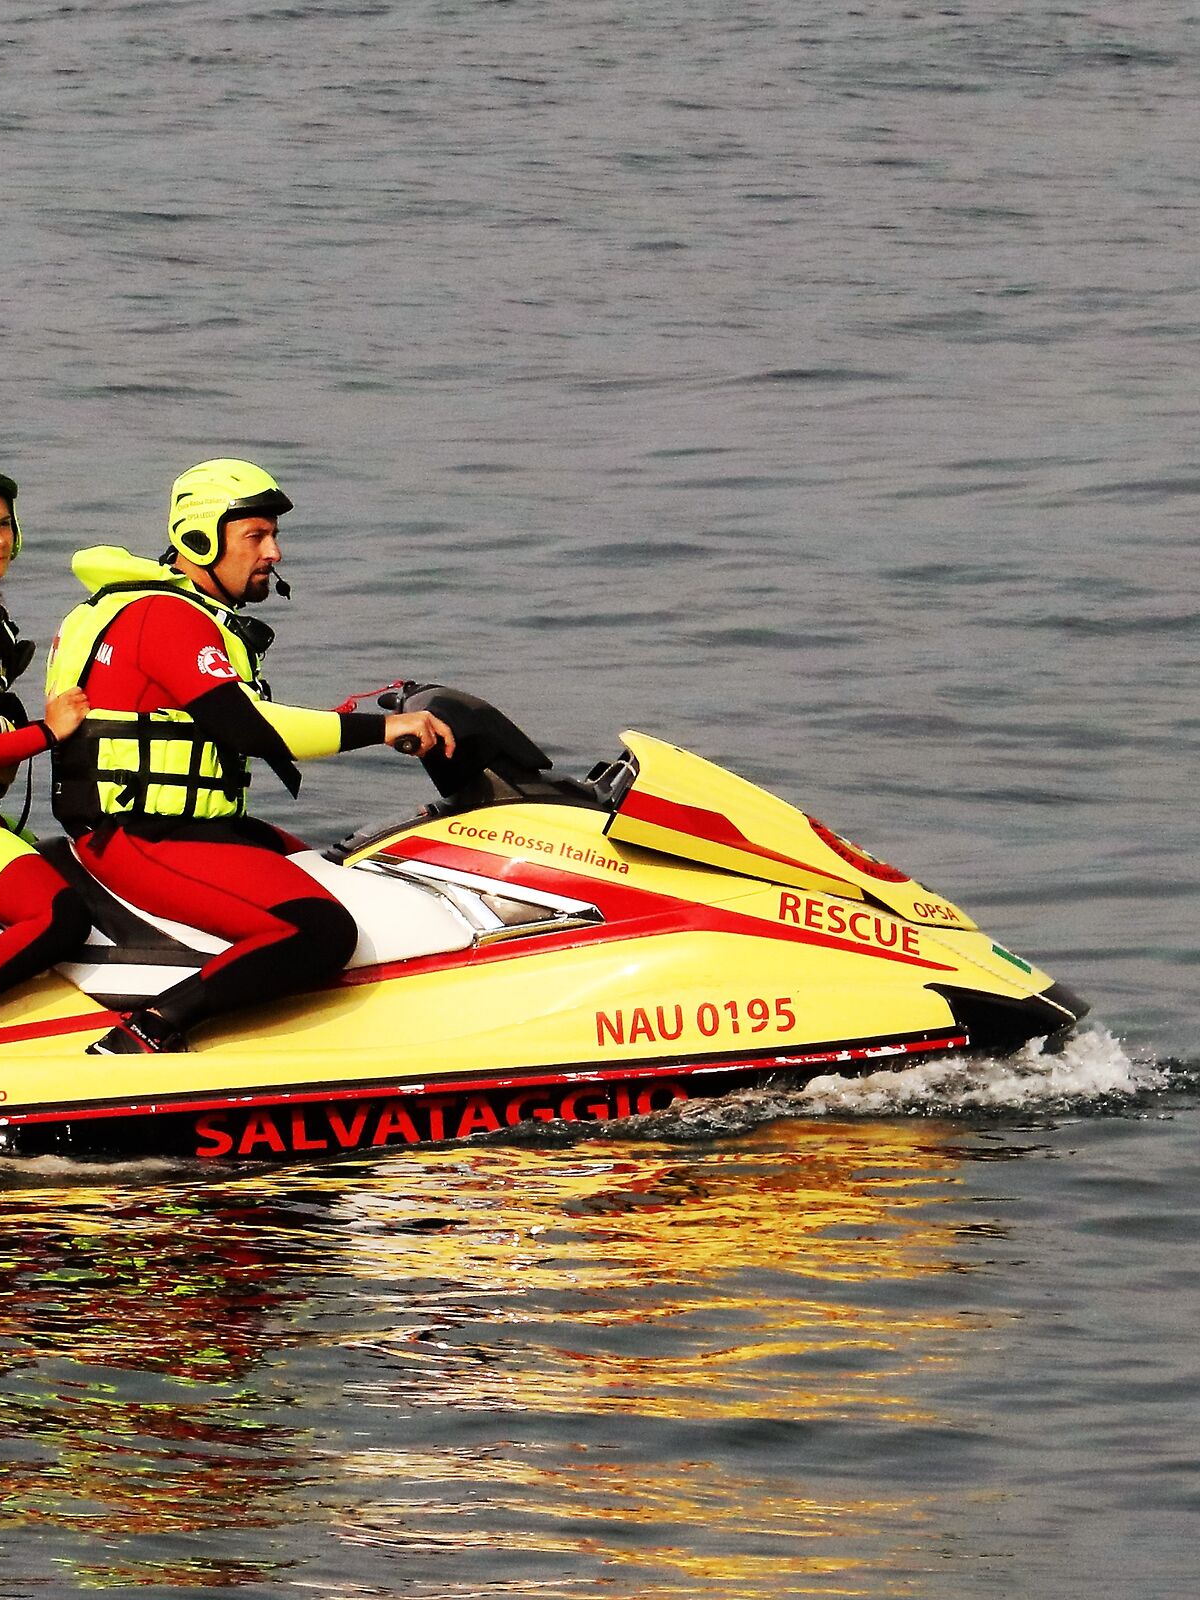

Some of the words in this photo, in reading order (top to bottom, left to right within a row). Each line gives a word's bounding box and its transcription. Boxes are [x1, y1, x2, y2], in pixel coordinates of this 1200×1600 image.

[447, 821, 498, 841] Croce
[502, 830, 554, 854] Rossa
[559, 842, 630, 875] Italiana
[778, 891, 921, 956] RESCUE
[913, 902, 960, 922] OPSA
[595, 1003, 684, 1047] NAU
[696, 997, 797, 1038] 0195
[196, 1083, 689, 1158] SALVATAGGIO
